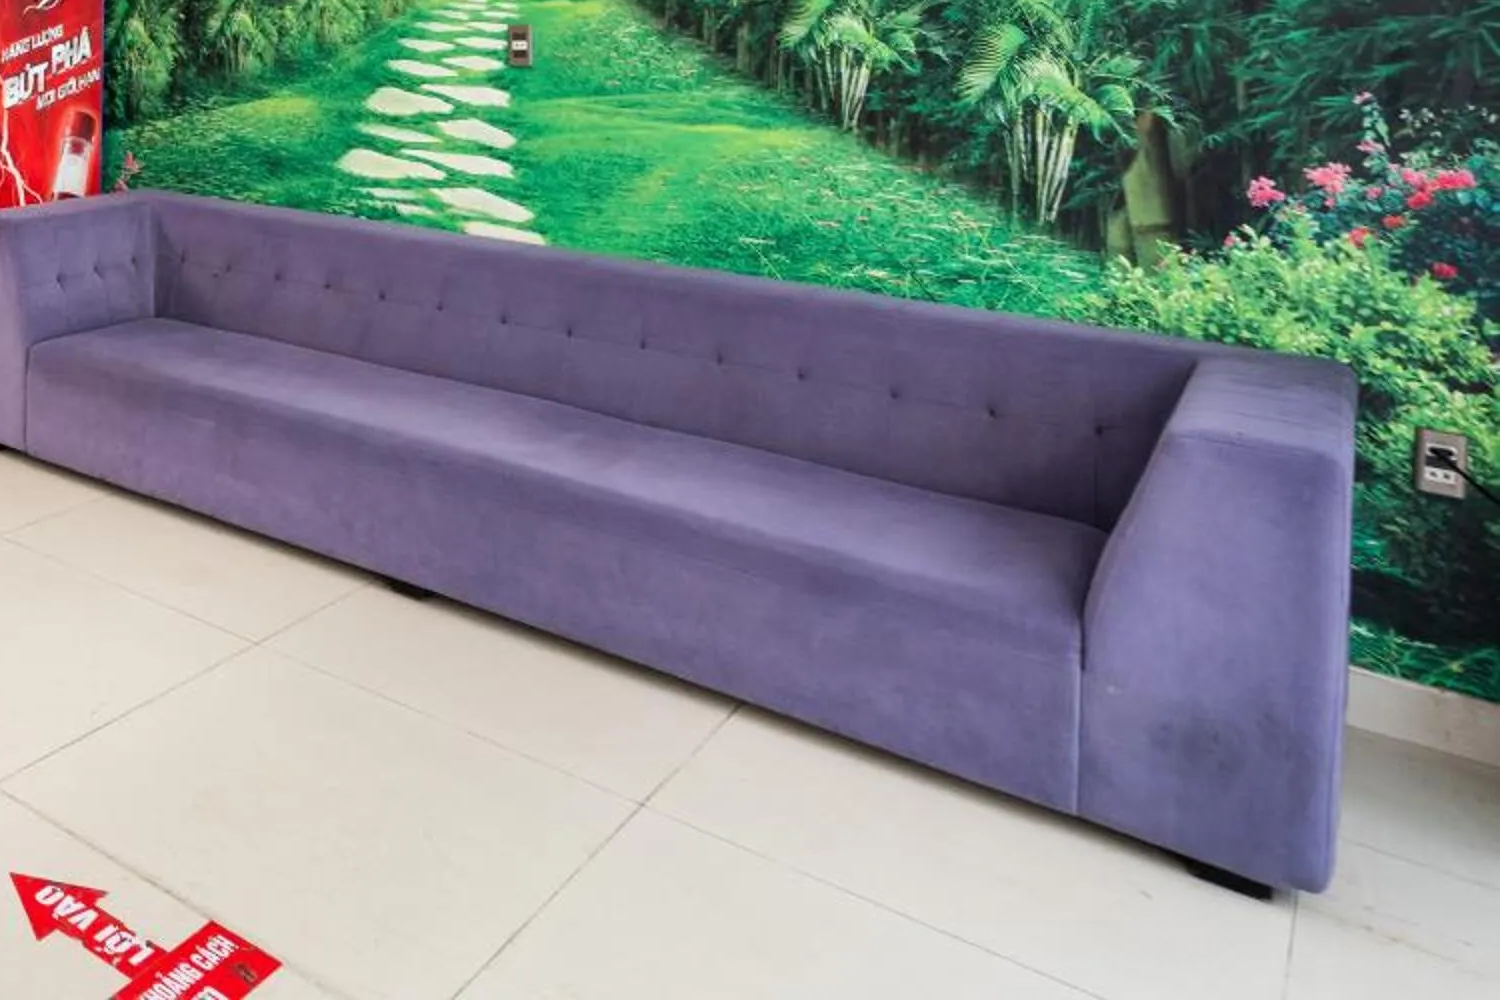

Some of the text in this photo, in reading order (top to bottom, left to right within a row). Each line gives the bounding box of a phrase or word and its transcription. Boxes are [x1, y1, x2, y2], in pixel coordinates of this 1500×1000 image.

[51, 26, 92, 75] PHÁ
[34, 884, 99, 931] VÀO
[189, 933, 239, 972] CÁCH
